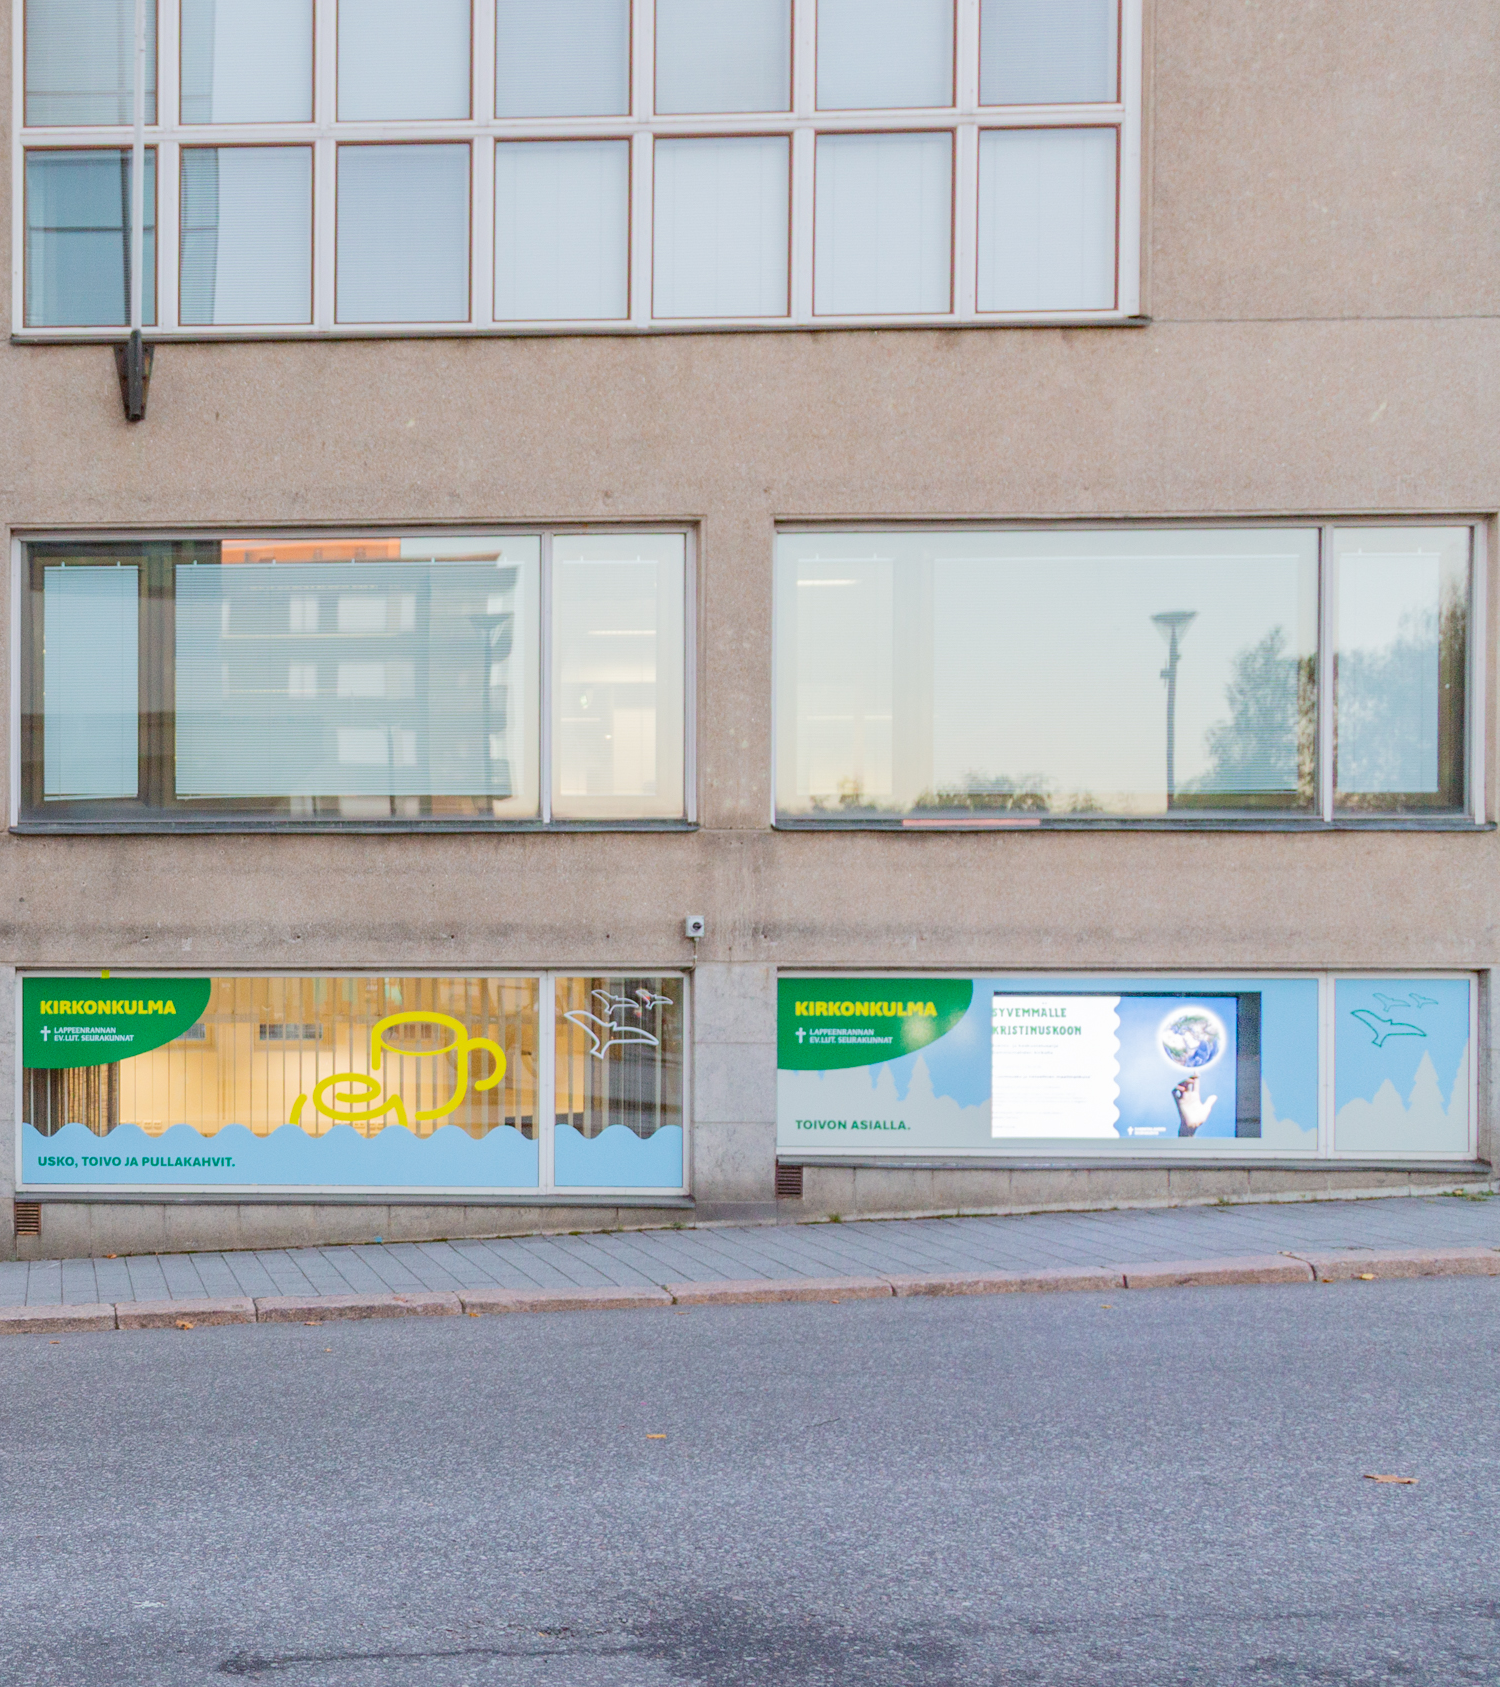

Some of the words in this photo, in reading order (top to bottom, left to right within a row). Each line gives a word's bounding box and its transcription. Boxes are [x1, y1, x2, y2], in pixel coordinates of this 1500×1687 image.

[40, 1000, 177, 1015] KIRKONKULMA
[795, 1001, 938, 1017] KIRKONKULMA
[992, 1025, 1082, 1036] KRISTINUSKOON
[838, 1036, 893, 1044] SEURAKUNNAT
[795, 1120, 847, 1130] TOIVON
[850, 1120, 911, 1130] ASIALLA.
[38, 1156, 78, 1168] USKO,
[81, 1156, 122, 1167] TOIVO
[125, 1156, 139, 1167] JA
[142, 1156, 236, 1167] PULLAKAHVIT.
